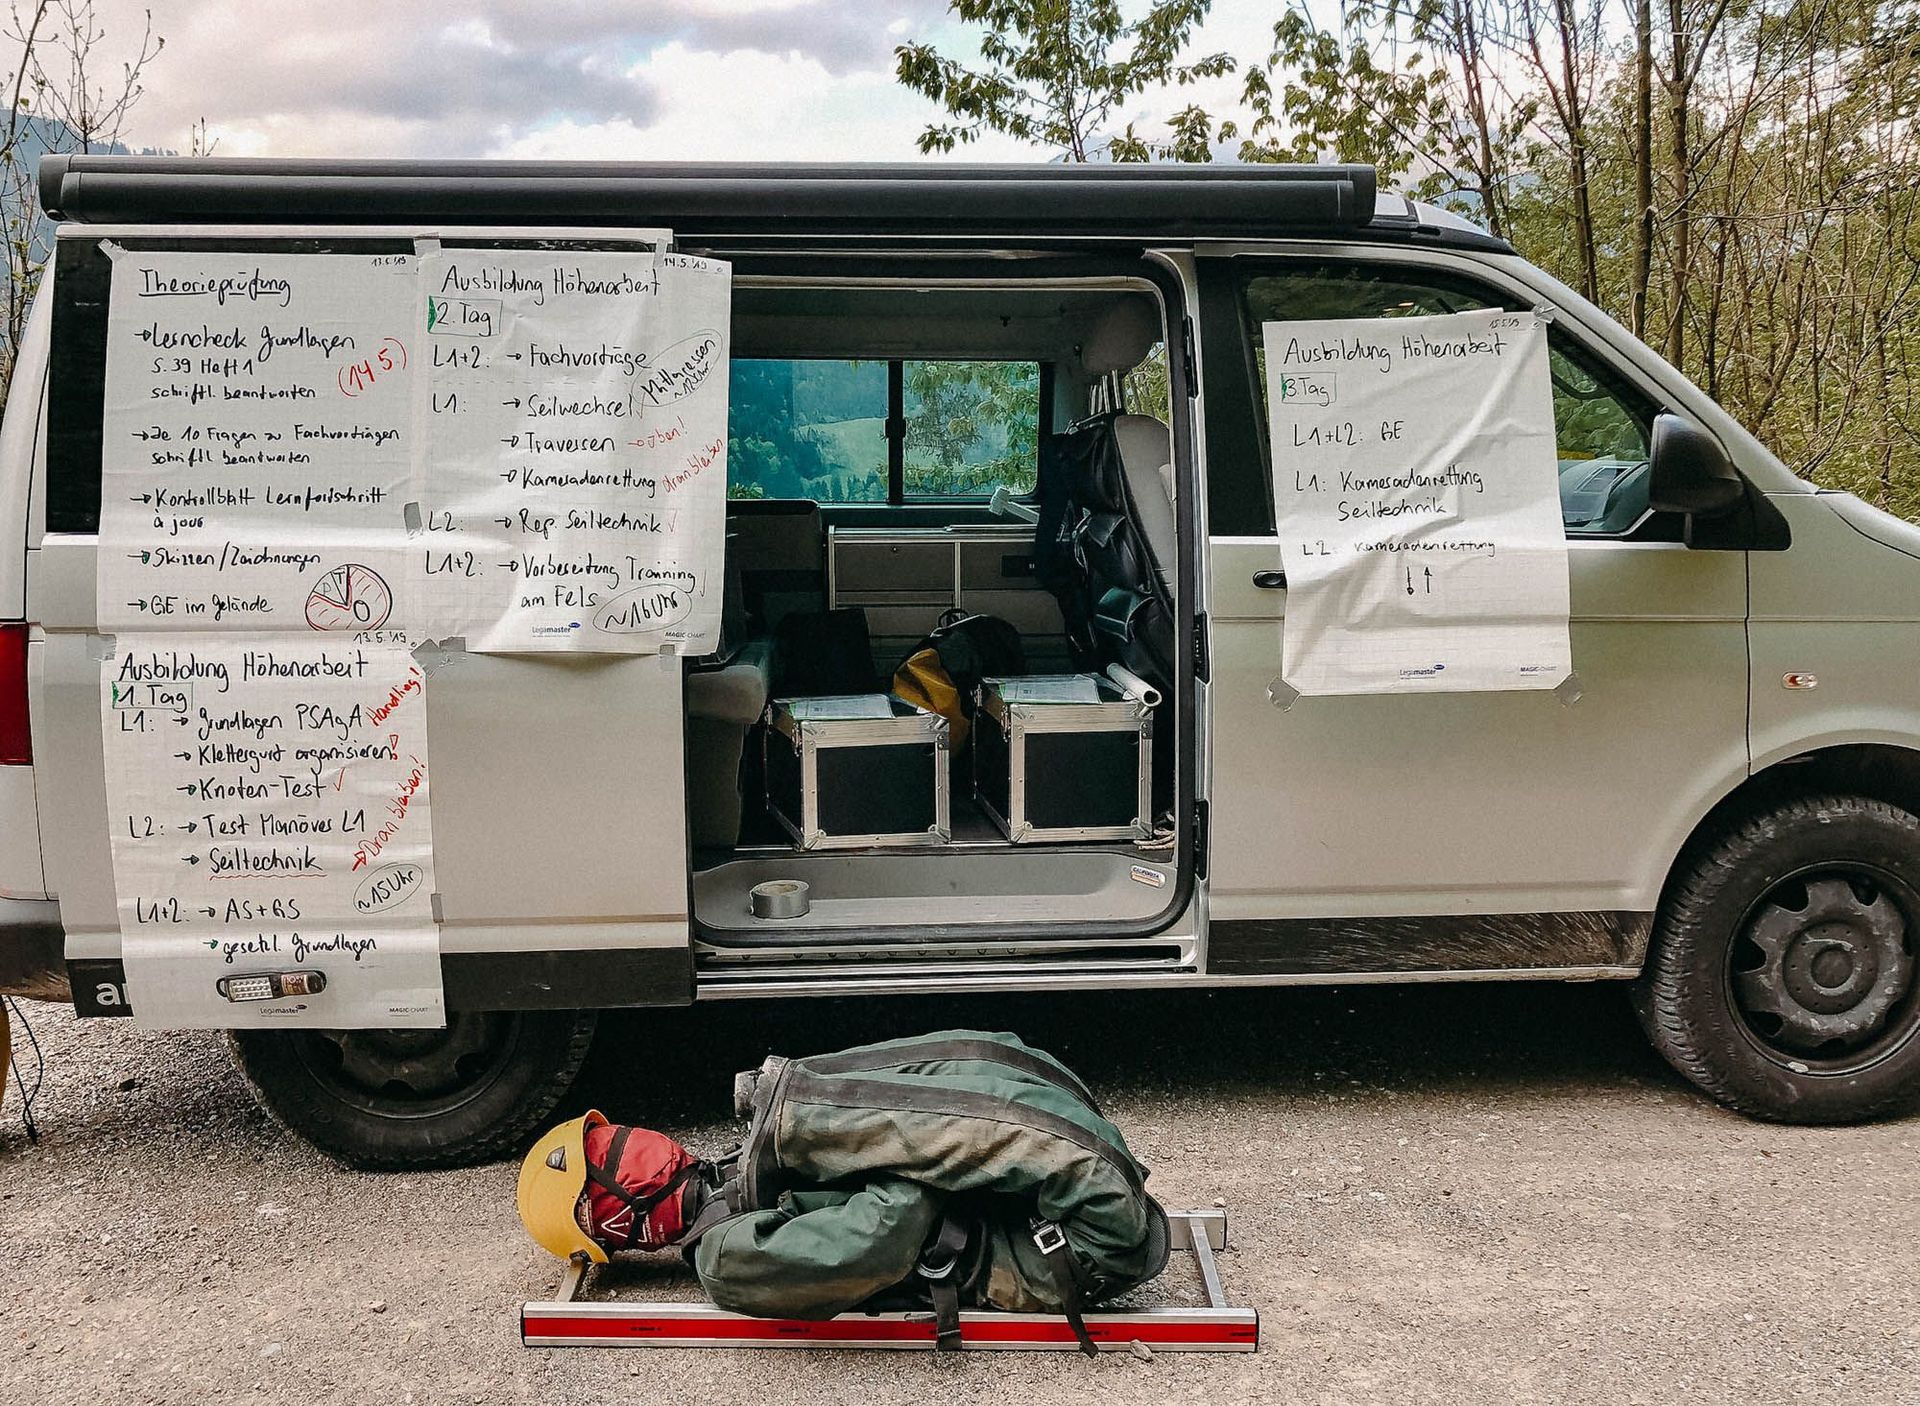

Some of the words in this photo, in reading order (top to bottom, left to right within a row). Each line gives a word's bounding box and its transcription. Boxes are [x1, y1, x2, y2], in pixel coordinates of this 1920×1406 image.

[139, 268, 291, 307] Theorieprüfung
[441, 265, 544, 306] Ausbildung
[553, 268, 661, 296] Höhenarbeit
[459, 302, 492, 337] Tag
[152, 322, 248, 349] Lerncheck
[530, 343, 651, 376] Fachvorträge
[1284, 338, 1391, 372] Ausbildung
[1402, 333, 1508, 359] Höhenarbeit
[171, 359, 192, 374] 39
[201, 358, 238, 377] Heft
[223, 384, 316, 400] beantworten
[432, 393, 467, 414] L1:
[527, 393, 633, 418] Seilwechsel
[181, 425, 200, 442] 10
[206, 427, 257, 449] Fragen
[265, 430, 282, 442] zu
[293, 424, 400, 446] Fachvorträgen
[525, 431, 616, 453] Traversen
[223, 449, 311, 466] beantworten
[523, 466, 655, 498] Kameradenrettung
[1296, 471, 1326, 492] L1:
[1340, 466, 1483, 493] Kameradenrettung
[155, 487, 256, 507] Kontrollblatt
[266, 486, 387, 511] Lernfortschritt
[1338, 498, 1447, 522] Seiltechnik
[565, 510, 662, 533] Seiltechnik
[1354, 538, 1496, 557] Kameradenrettung
[523, 553, 619, 589] Vorbereitung
[626, 556, 695, 593] Training
[151, 595, 179, 615] GE
[185, 595, 205, 614] im
[212, 593, 274, 622] Gelände
[521, 594, 545, 608] am
[554, 585, 599, 608] Fels
[120, 652, 229, 692] Ausbildung
[244, 650, 368, 681] Höhenarbeit
[146, 685, 187, 713] Tag
[121, 710, 154, 732] L1:
[297, 704, 363, 739] PSAgA
[199, 744, 285, 773] Klettergurt
[199, 777, 326, 800] Knoten-Test
[129, 816, 164, 838] L2:
[204, 815, 249, 836] Test
[261, 811, 332, 834] Manöver
[210, 847, 322, 873] Seiltechnik
